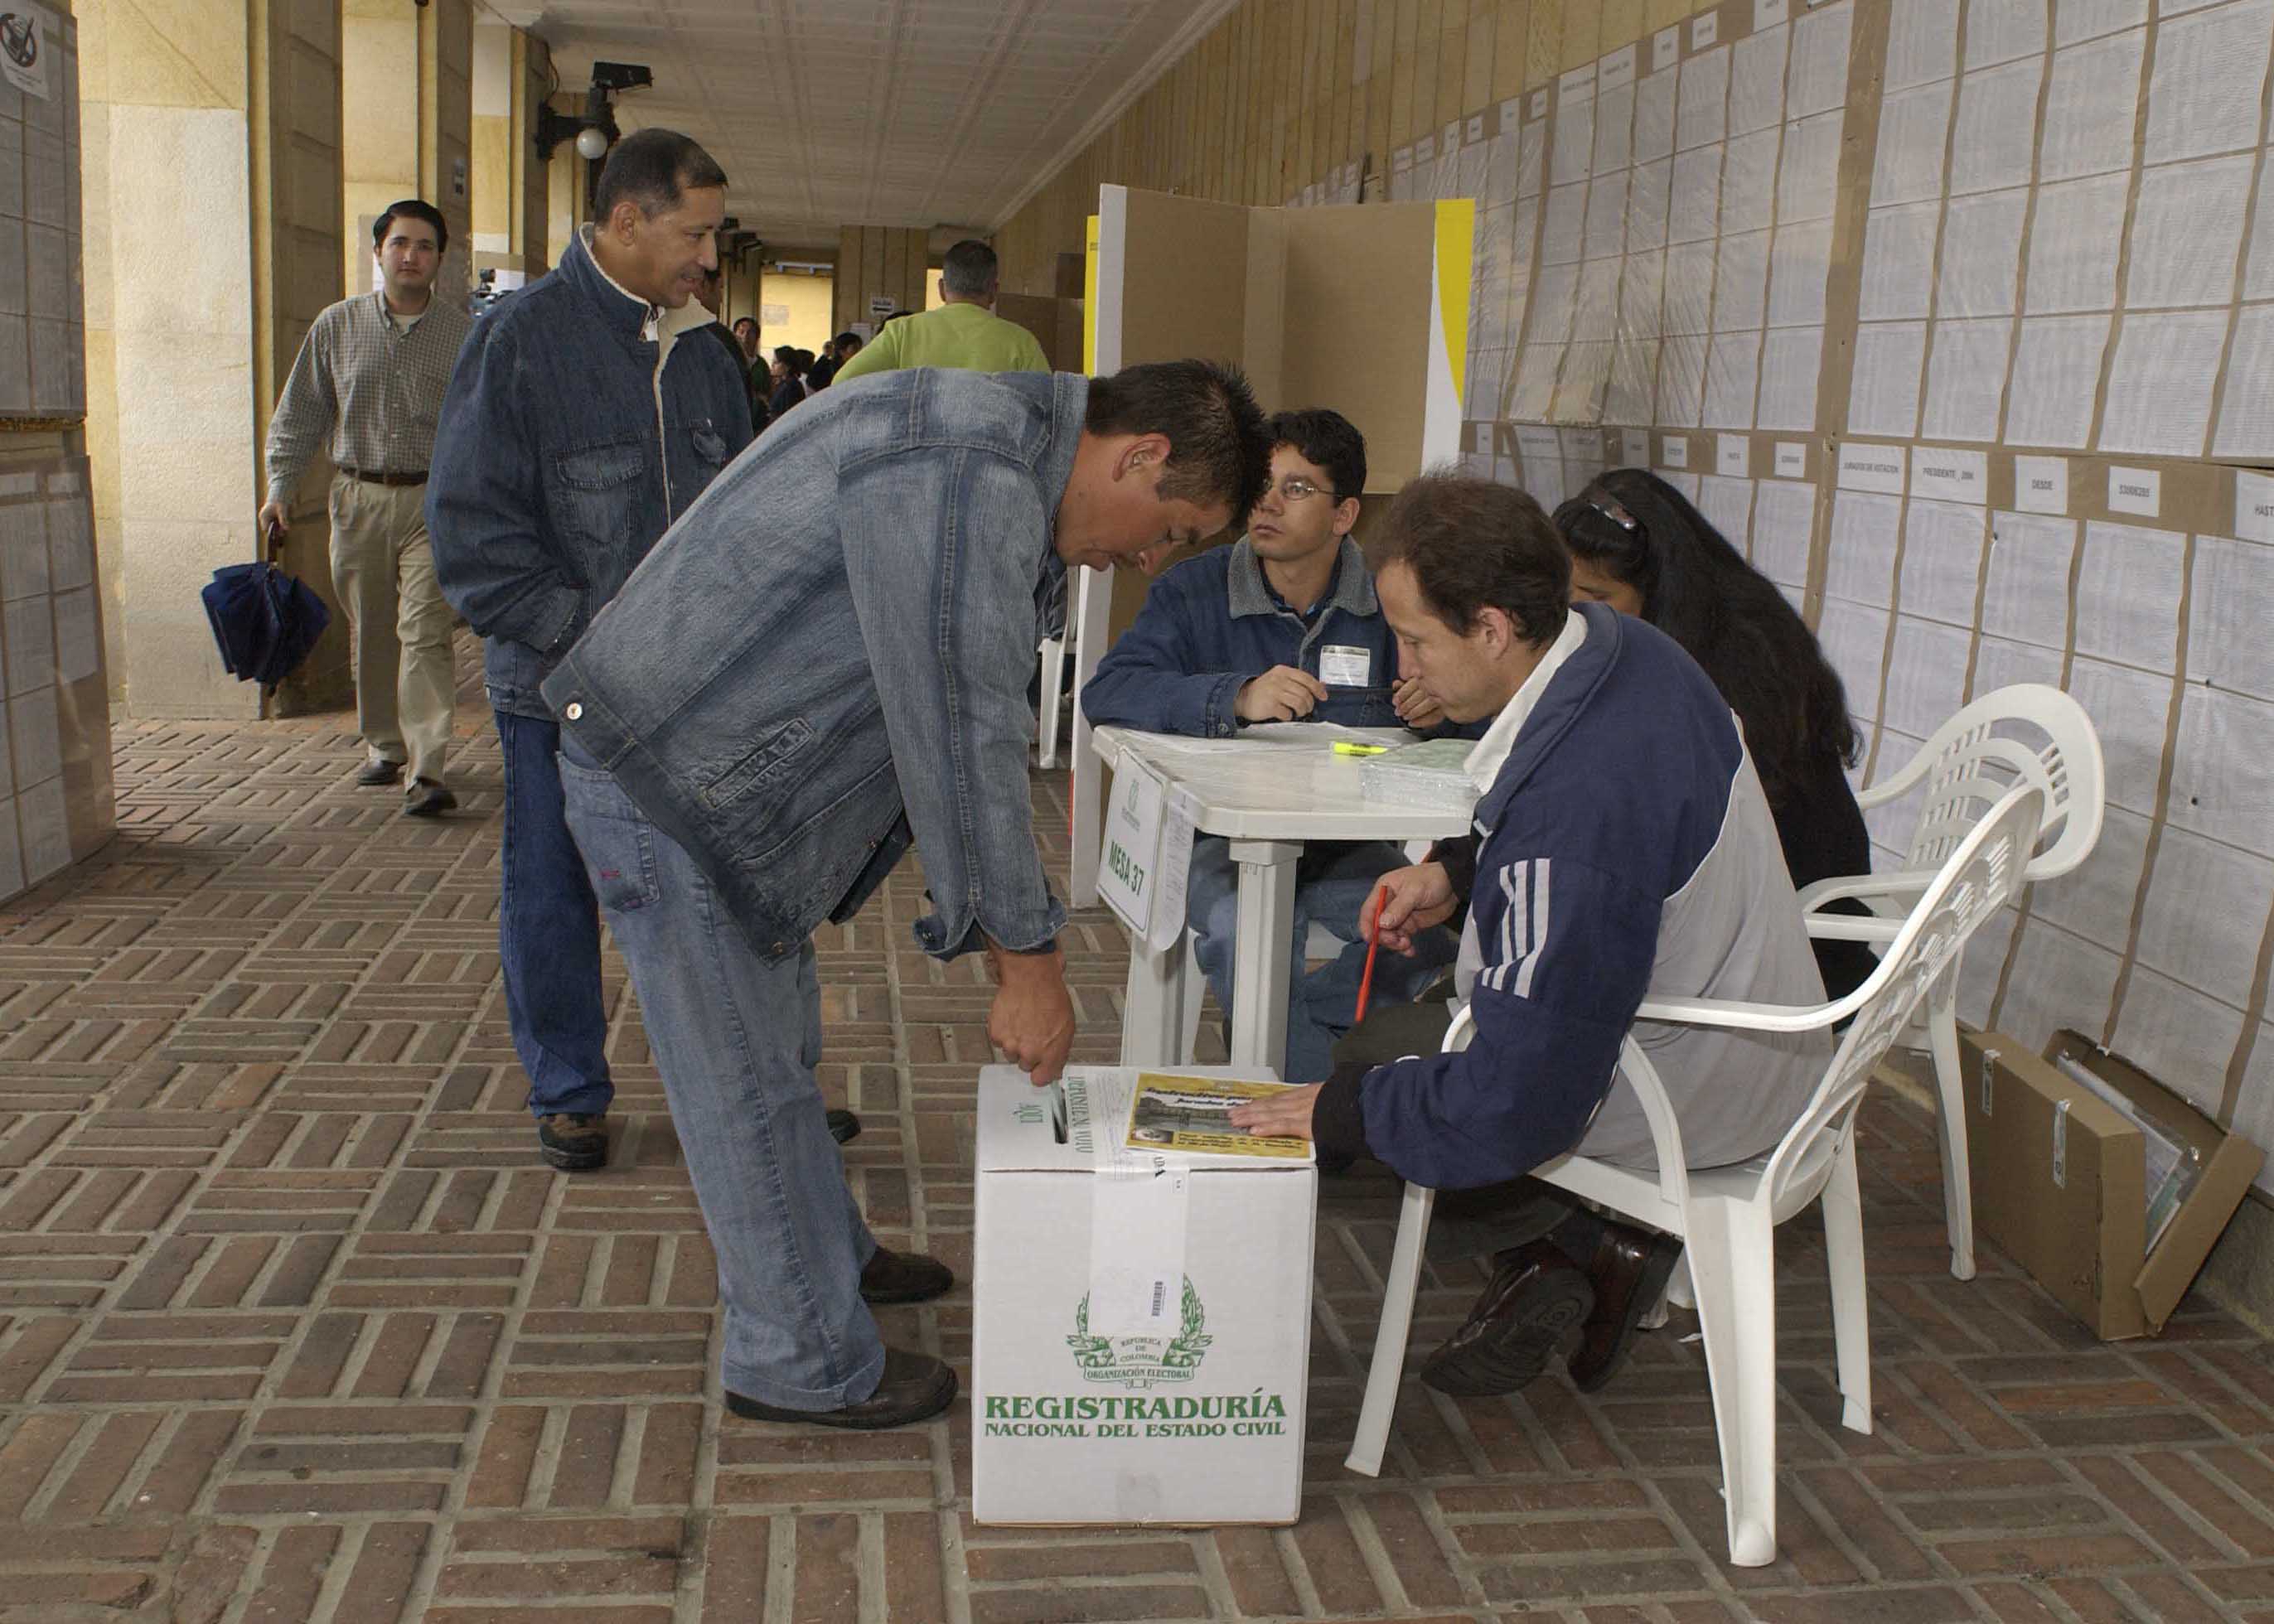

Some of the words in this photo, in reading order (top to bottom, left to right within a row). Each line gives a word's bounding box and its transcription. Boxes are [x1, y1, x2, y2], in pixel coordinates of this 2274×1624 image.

[1108, 839, 1130, 886] MESA
[1131, 864, 1144, 897] 37
[1147, 1368, 1190, 1379] ELECTORAL
[985, 1387, 1286, 1419] REGISTRADURÍA
[985, 1423, 1091, 1438] NACIONAL
[1097, 1423, 1139, 1438] DEL
[1145, 1423, 1227, 1438] ESTADO
[1232, 1422, 1286, 1436] CIVIL
